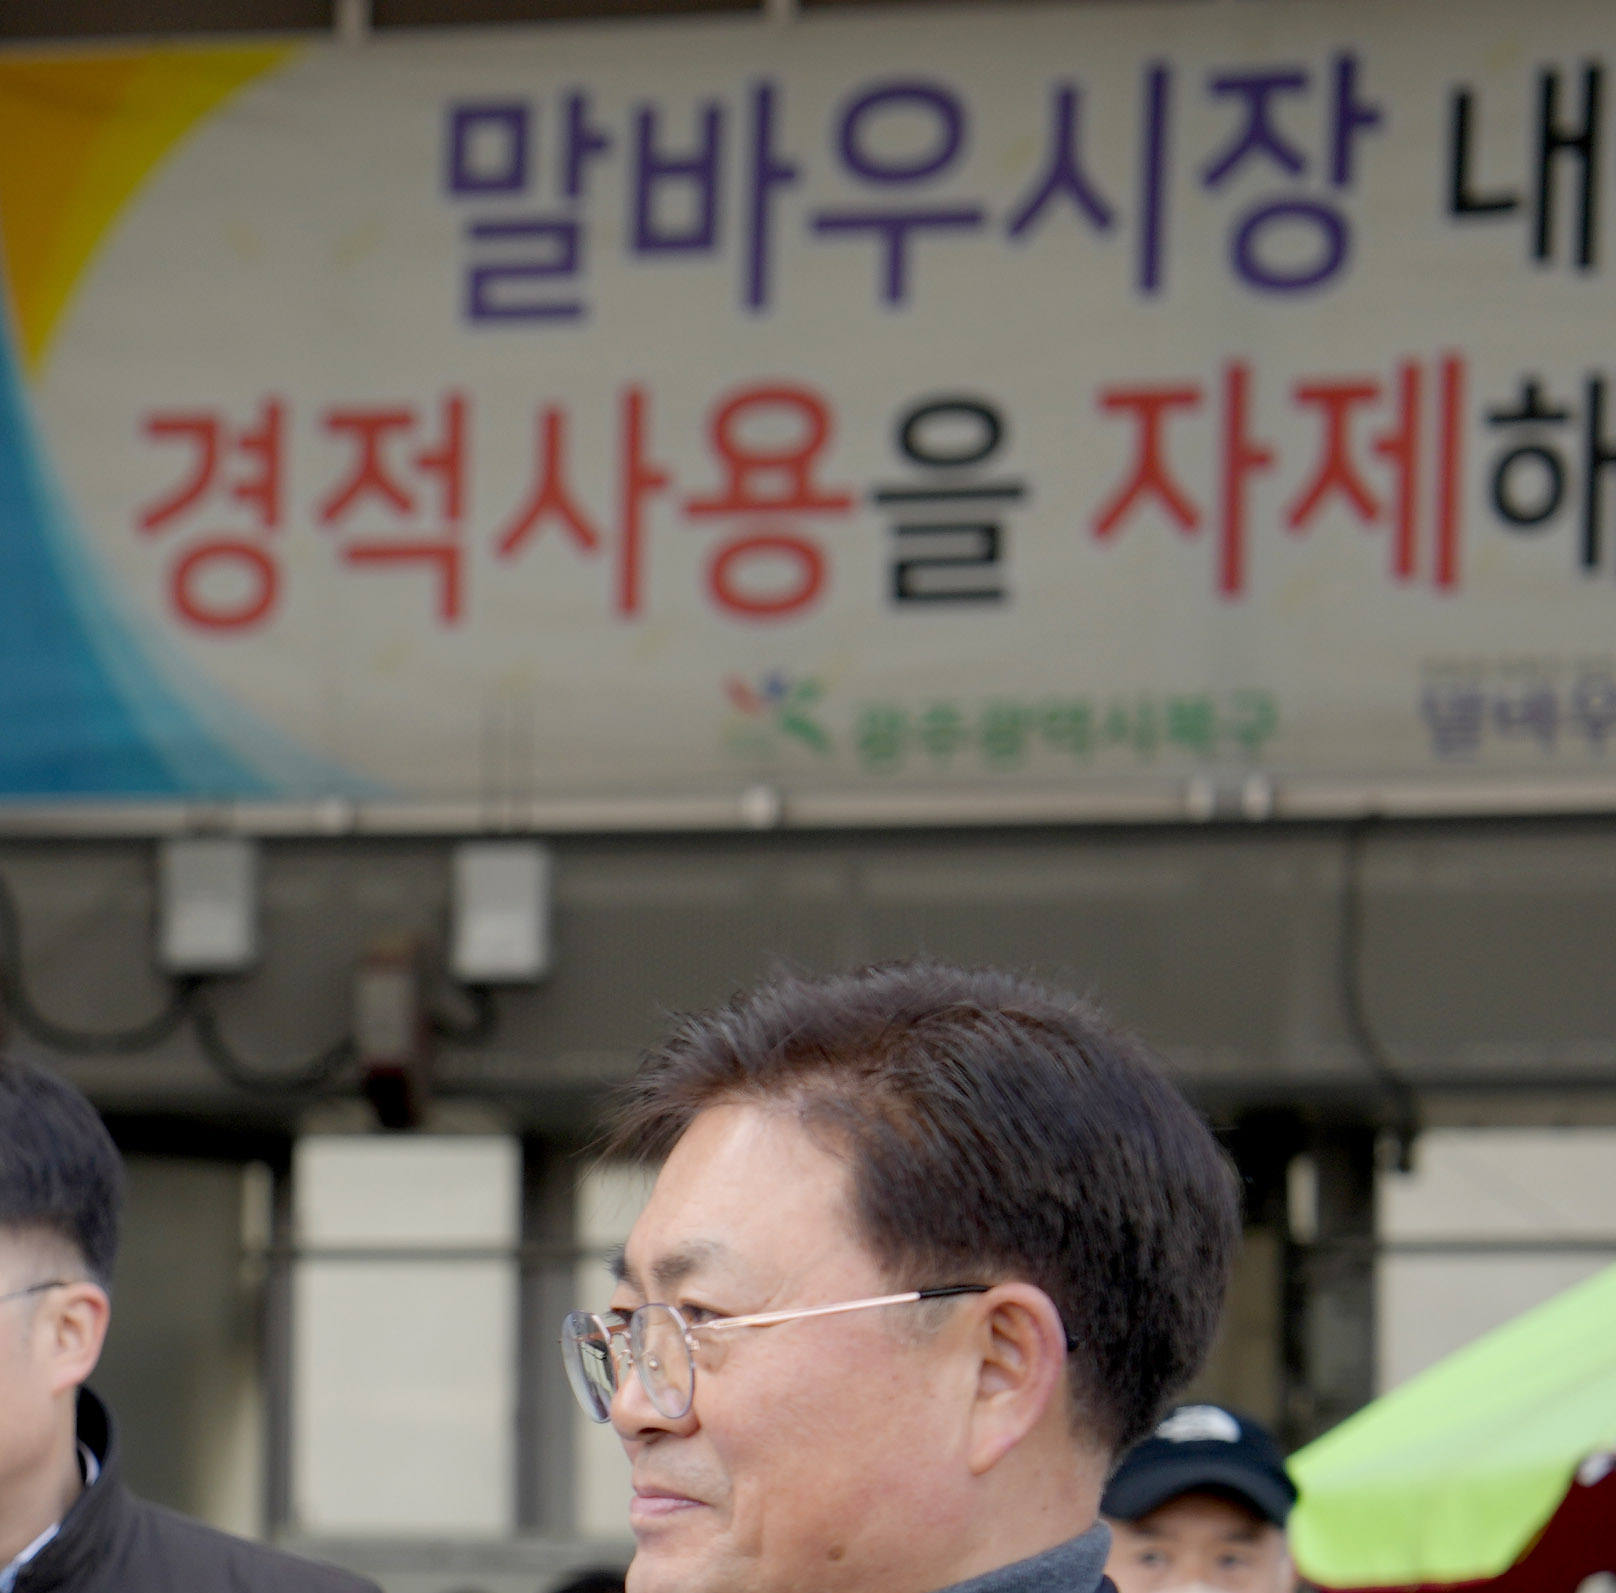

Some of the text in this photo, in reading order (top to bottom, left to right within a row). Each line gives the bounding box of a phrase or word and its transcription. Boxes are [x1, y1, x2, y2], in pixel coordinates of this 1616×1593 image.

[441, 46, 1602, 326] 말바우시장 내
[134, 380, 1029, 636] 경적사용을
